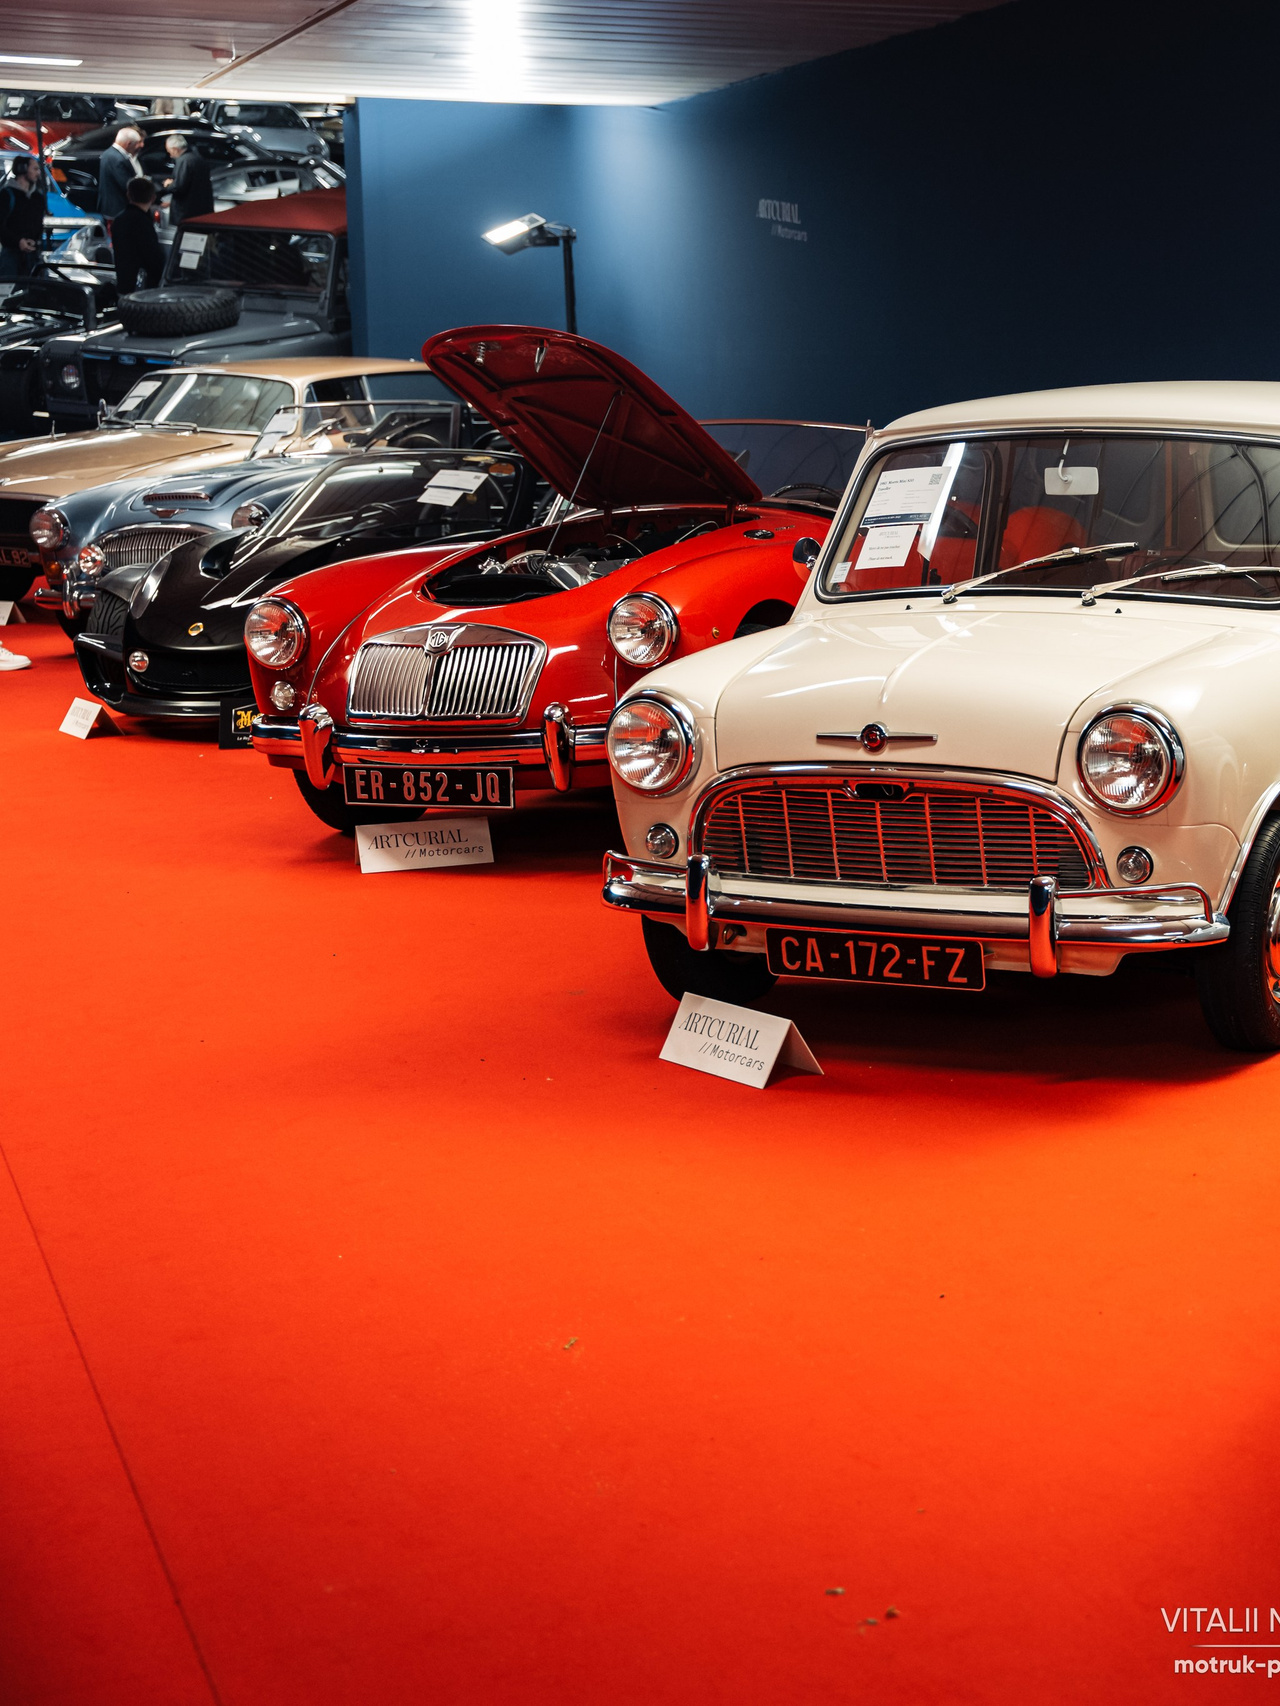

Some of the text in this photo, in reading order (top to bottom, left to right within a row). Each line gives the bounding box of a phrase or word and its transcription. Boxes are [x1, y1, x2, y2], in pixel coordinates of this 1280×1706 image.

[368, 828, 470, 850] ARTCURIAL
[780, 936, 968, 984] CA-172-FZ
[678, 1011, 761, 1051] ARTCURIAL
